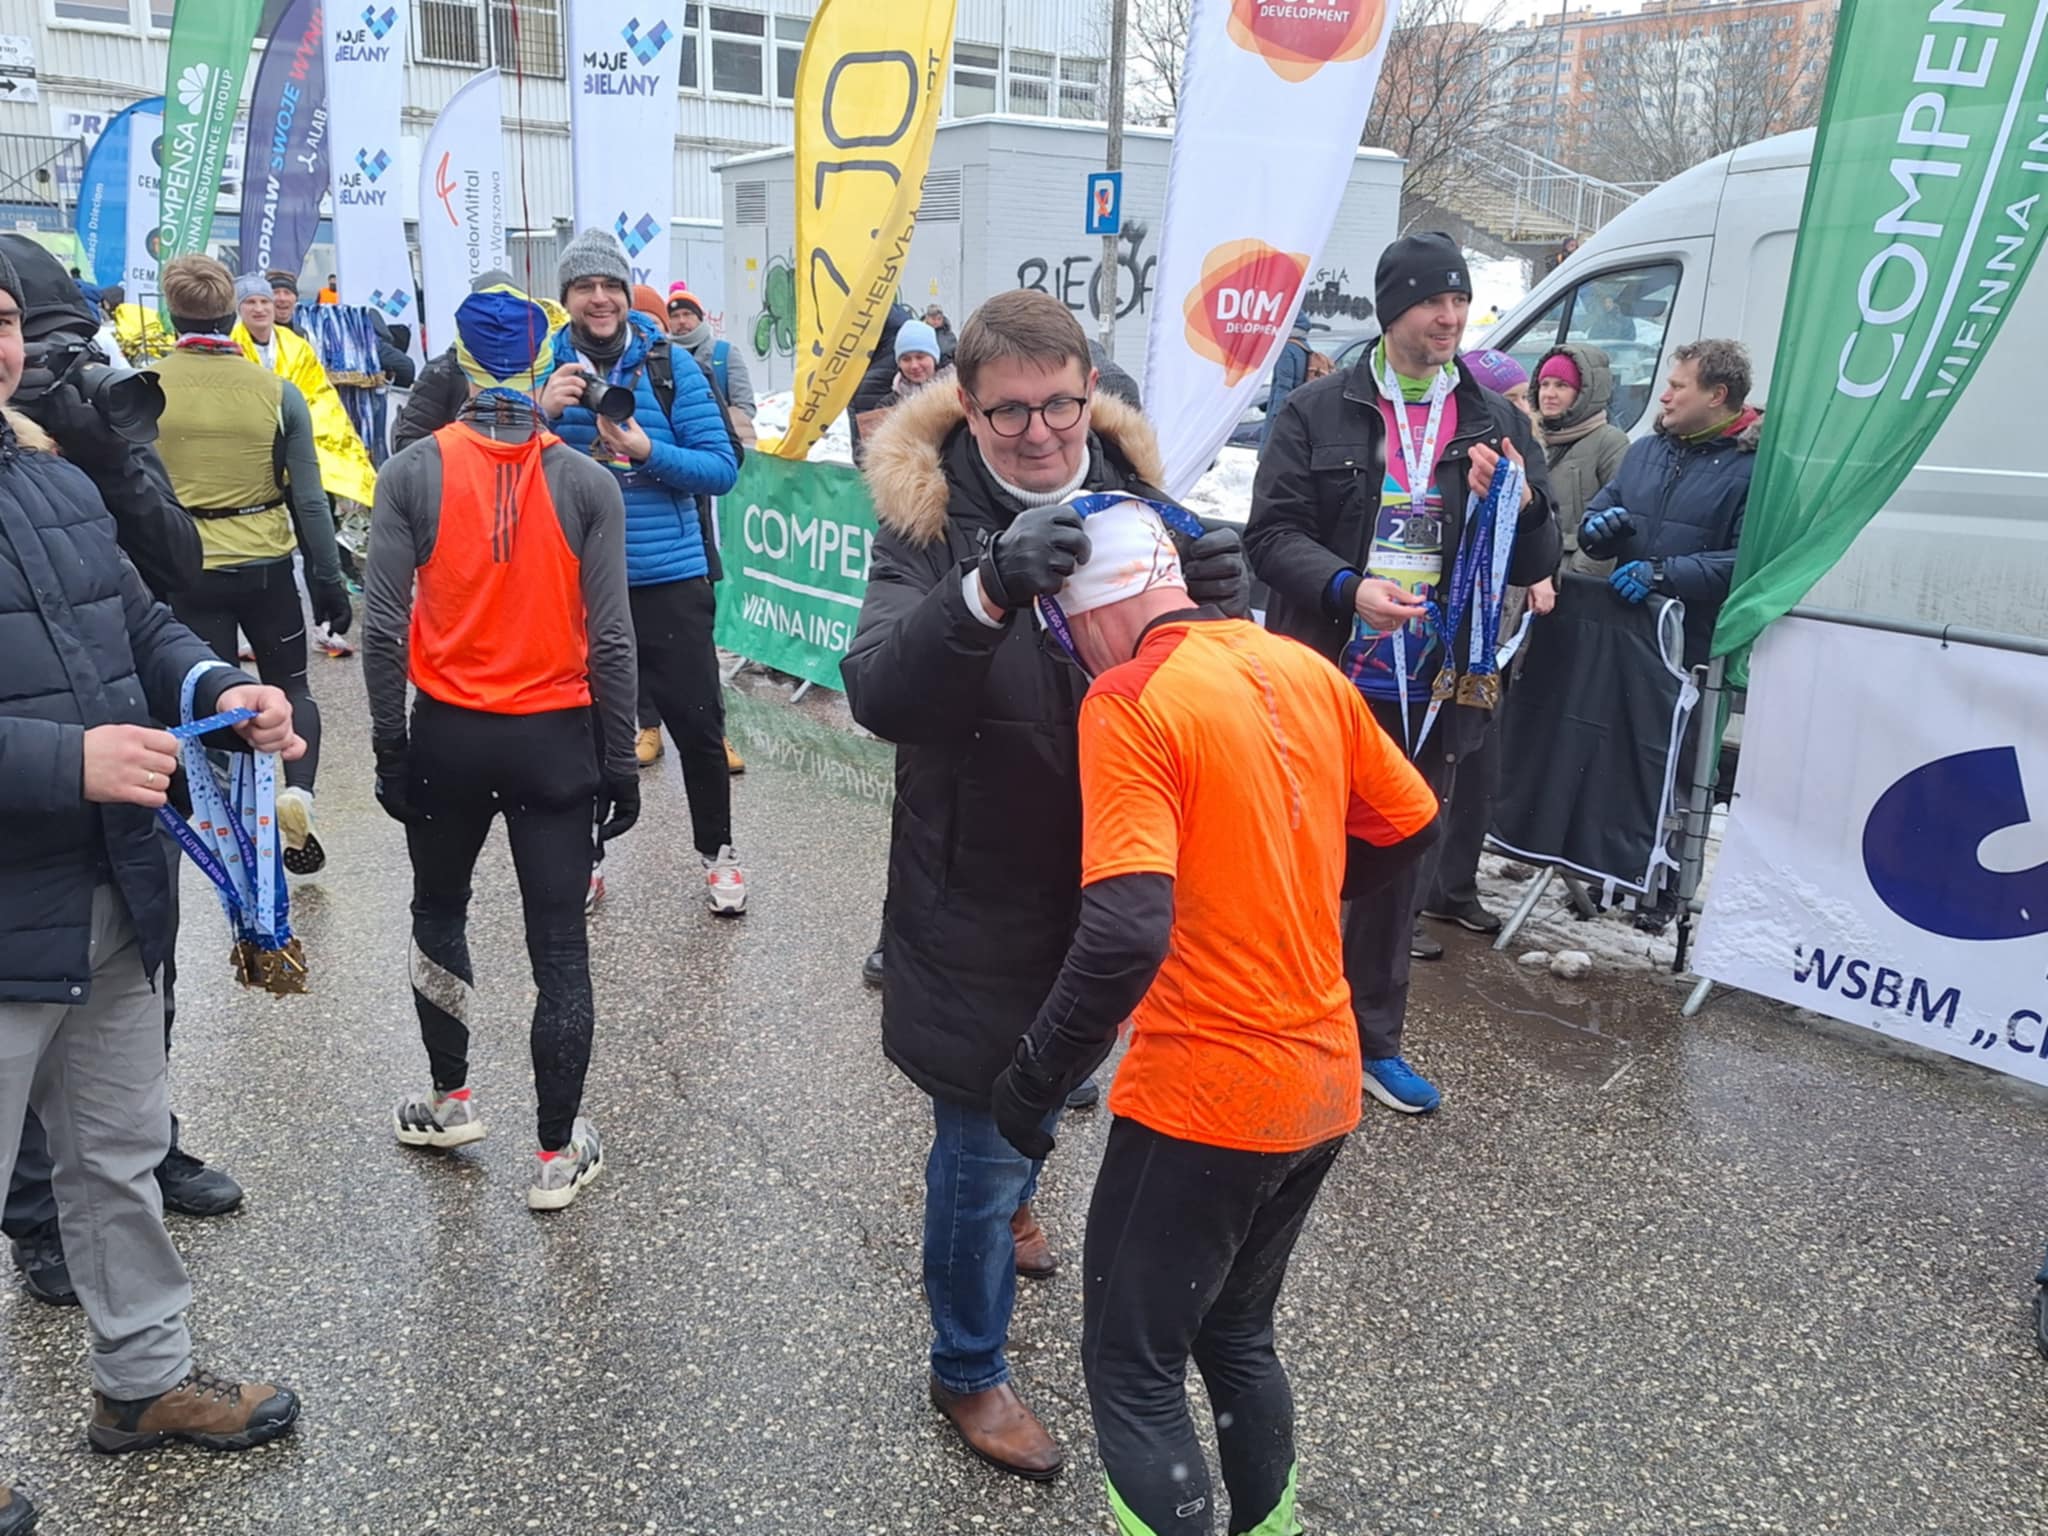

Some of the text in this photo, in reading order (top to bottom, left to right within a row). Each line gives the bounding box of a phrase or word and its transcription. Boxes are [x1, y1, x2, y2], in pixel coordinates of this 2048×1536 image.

[1260, 4, 1350, 23] DEVELOPMENT
[199, 125, 222, 212] INSURANCE
[213, 68, 234, 121] GROUP
[257, 174, 281, 279] OPRAW
[271, 82, 300, 172] SWOJE
[742, 591, 807, 641] VIENNA
[181, 833, 210, 865] LUTEGO
[1793, 944, 2048, 1060] WSBM „C
